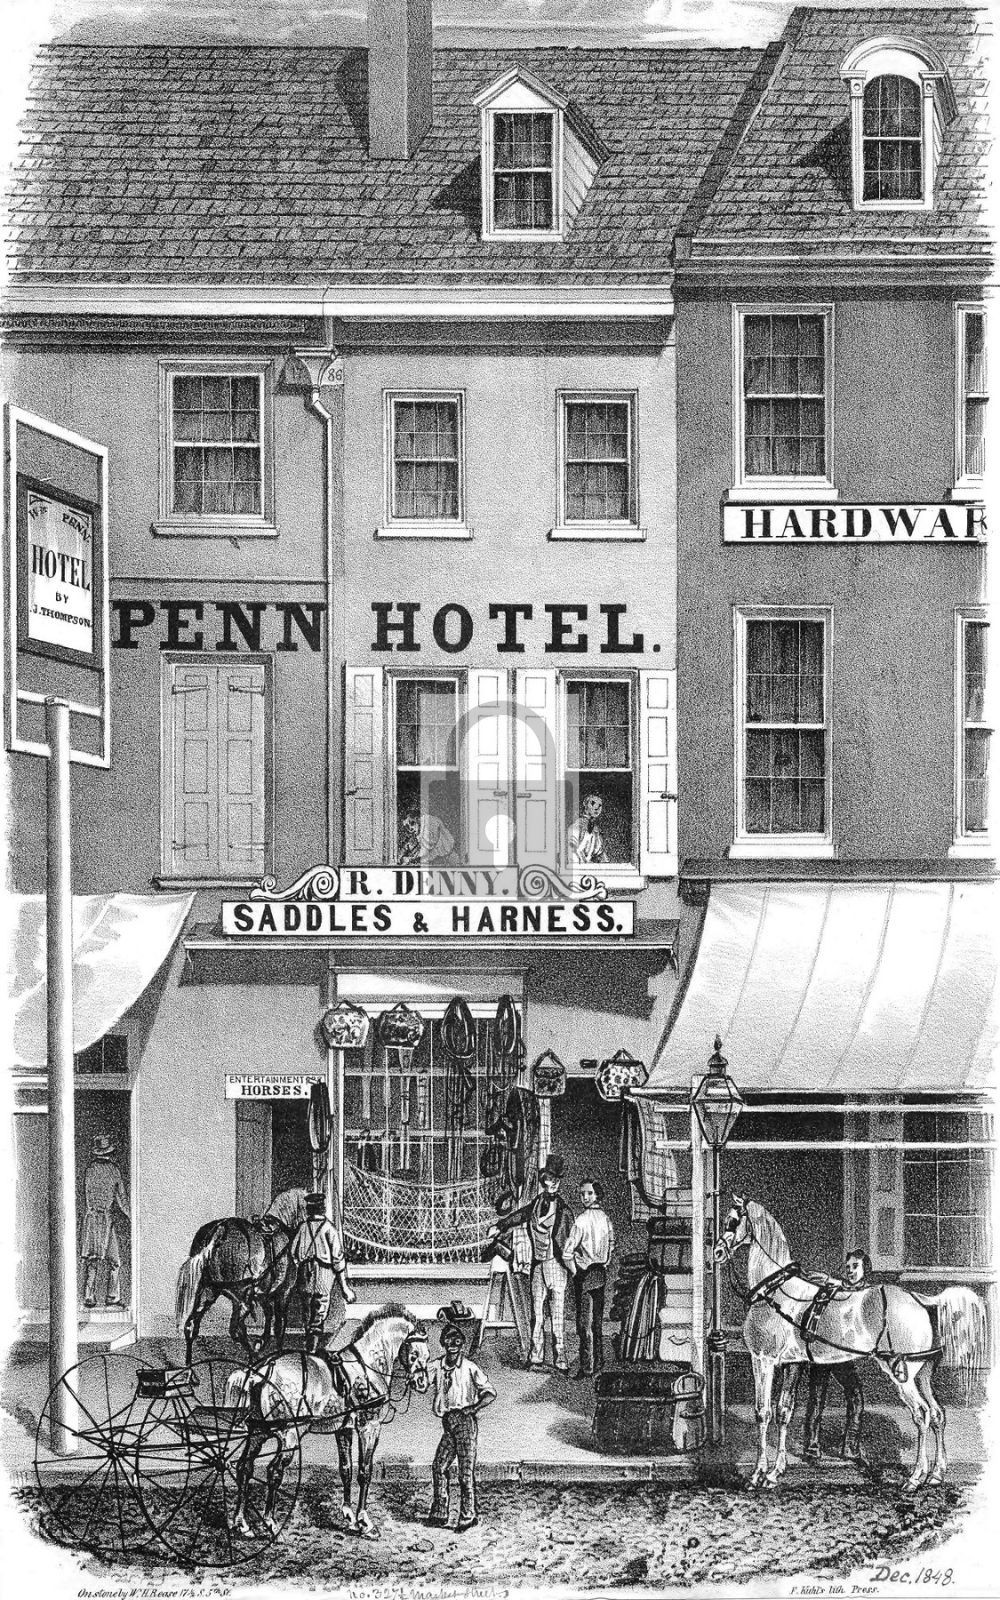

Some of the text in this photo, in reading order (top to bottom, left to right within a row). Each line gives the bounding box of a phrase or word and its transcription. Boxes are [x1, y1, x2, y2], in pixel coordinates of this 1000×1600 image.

[327, 368, 343, 381] 86
[31, 543, 91, 592] HOTEL
[55, 591, 69, 604] BY
[112, 602, 661, 653] PENN HOTEL.
[346, 870, 509, 896] R. DENNY.
[233, 903, 623, 933] SADDLES & HARNESS.
[229, 1076, 304, 1084] ENTERTAINMENT
[241, 1085, 308, 1096] HORSES.
[869, 1566, 955, 1586] Dec. 1848.
